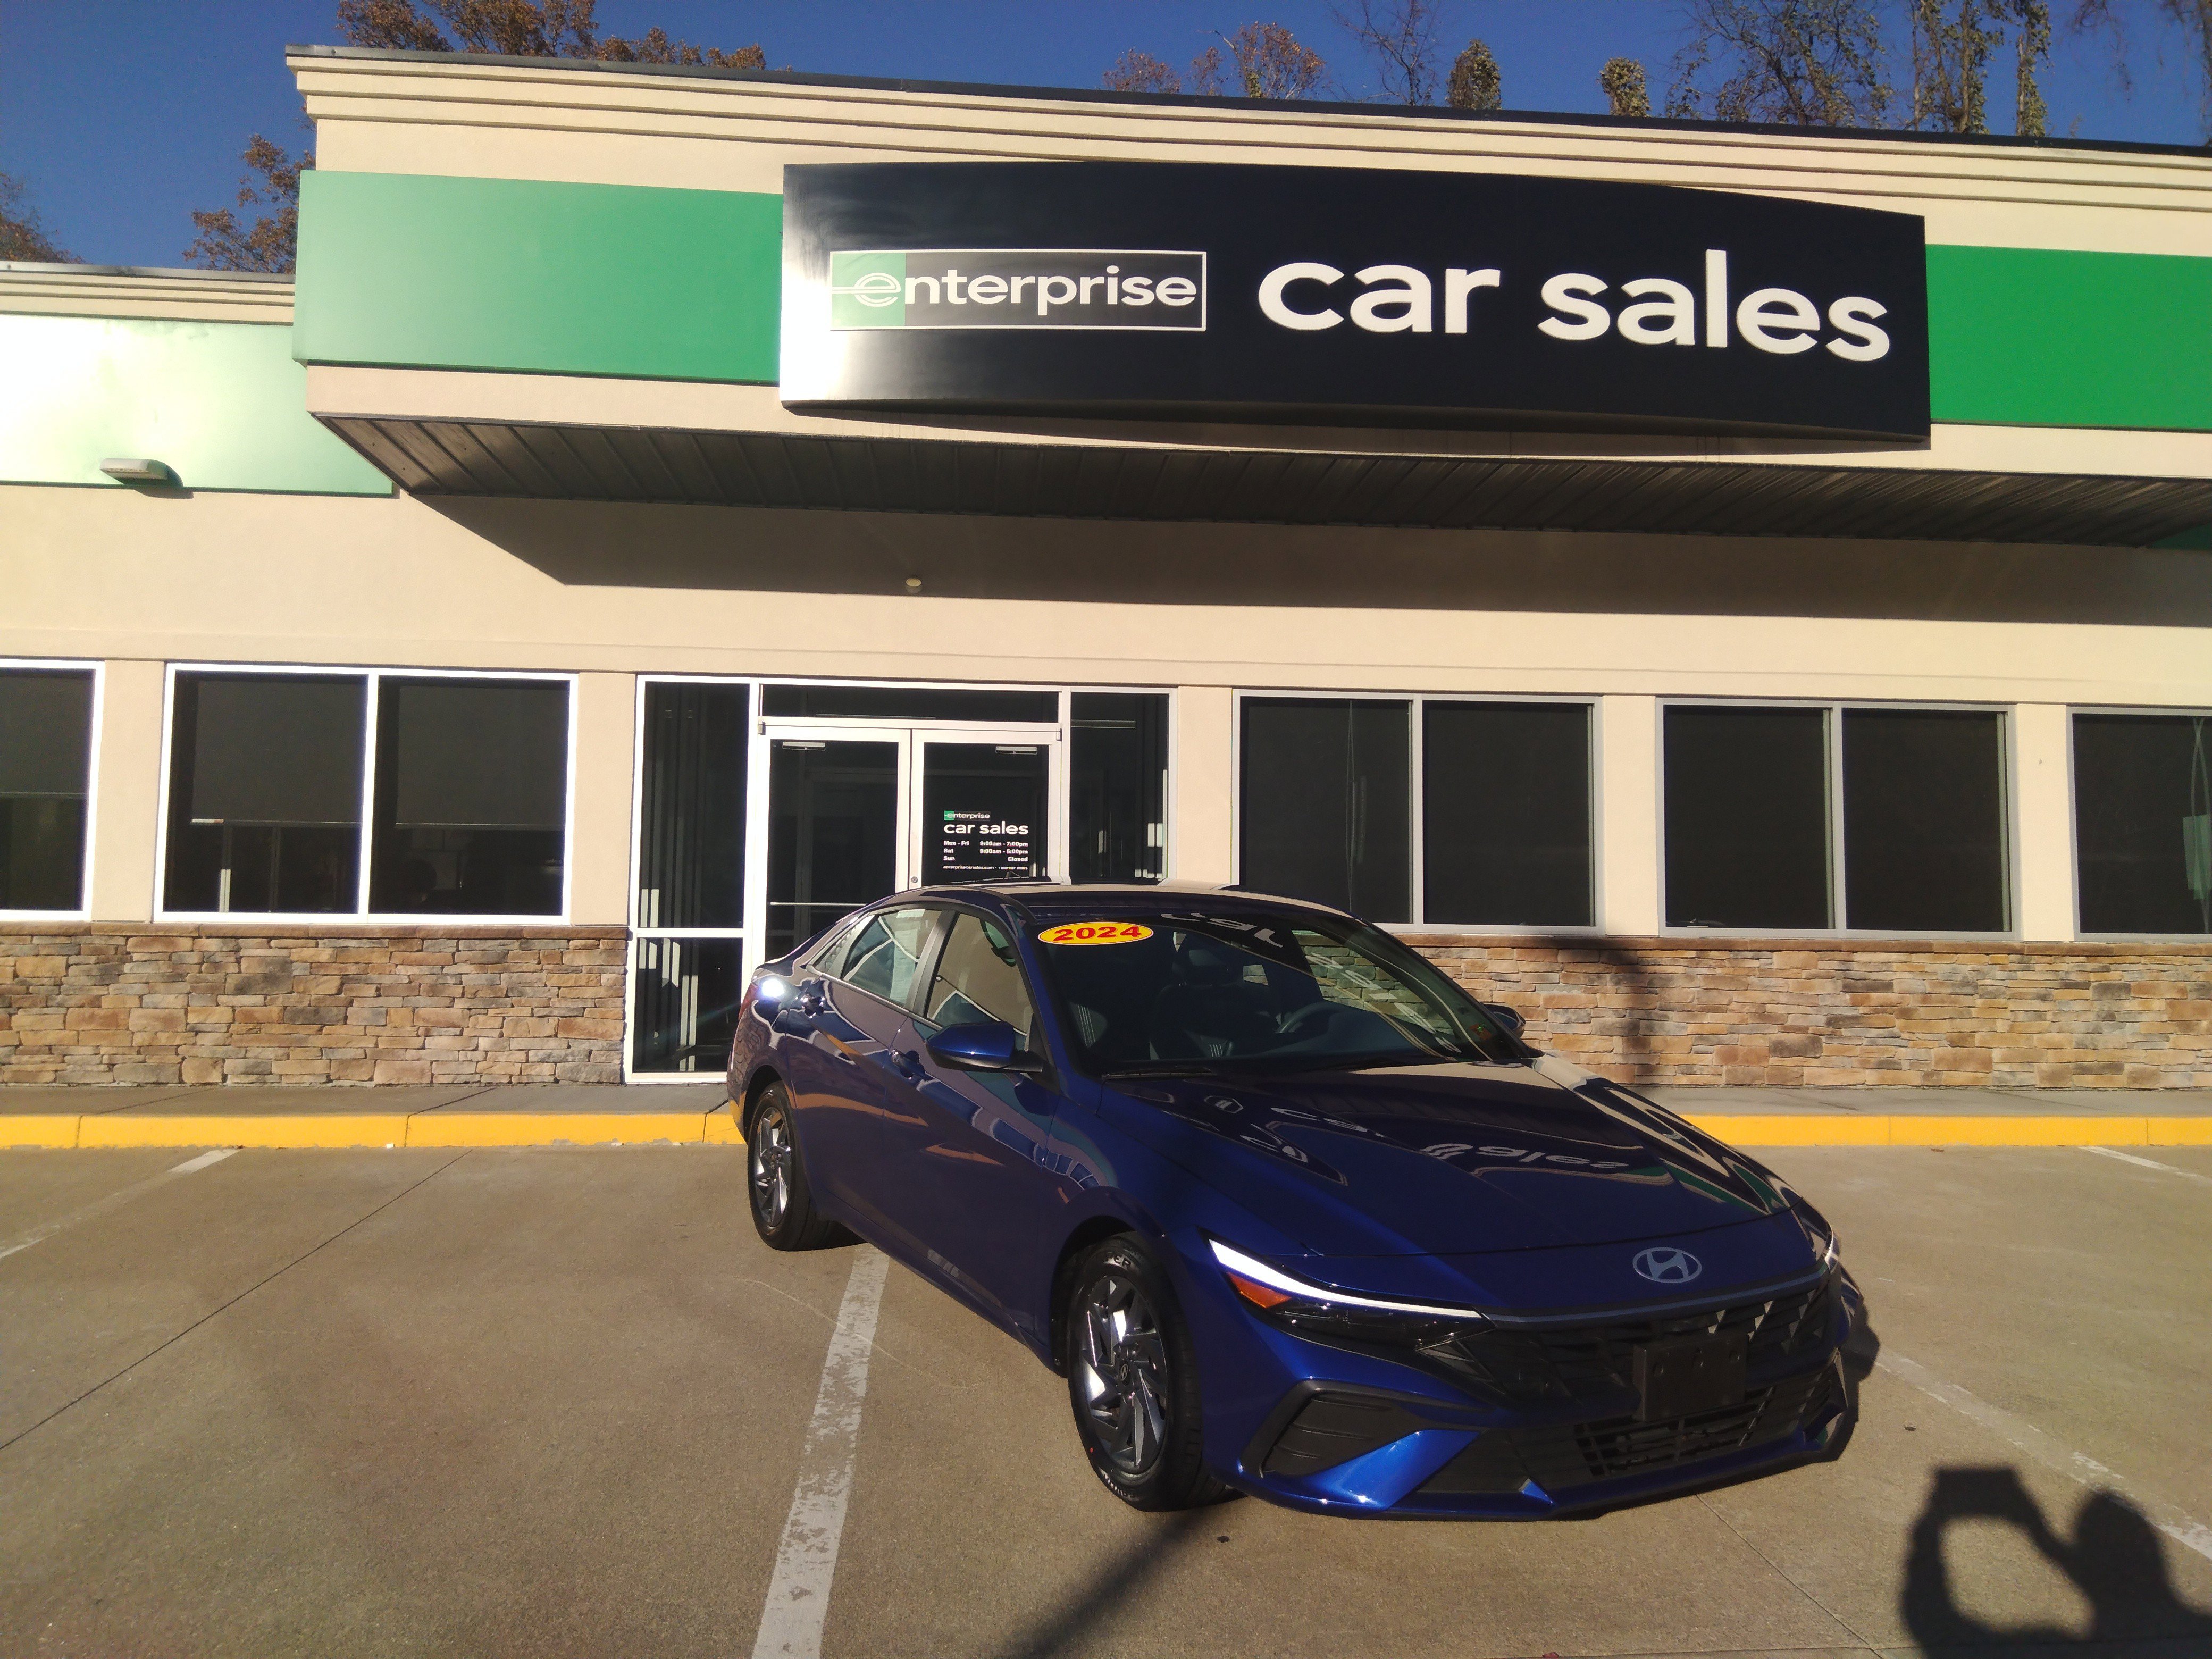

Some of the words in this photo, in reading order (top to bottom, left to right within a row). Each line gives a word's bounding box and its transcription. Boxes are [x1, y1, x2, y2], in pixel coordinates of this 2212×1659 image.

[850, 264, 1197, 316] enterprise
[1258, 262, 1501, 334] car
[1537, 248, 1890, 362] sales
[943, 824, 976, 834] car
[979, 820, 1029, 835] sales
[1052, 925, 1141, 942] 2024
